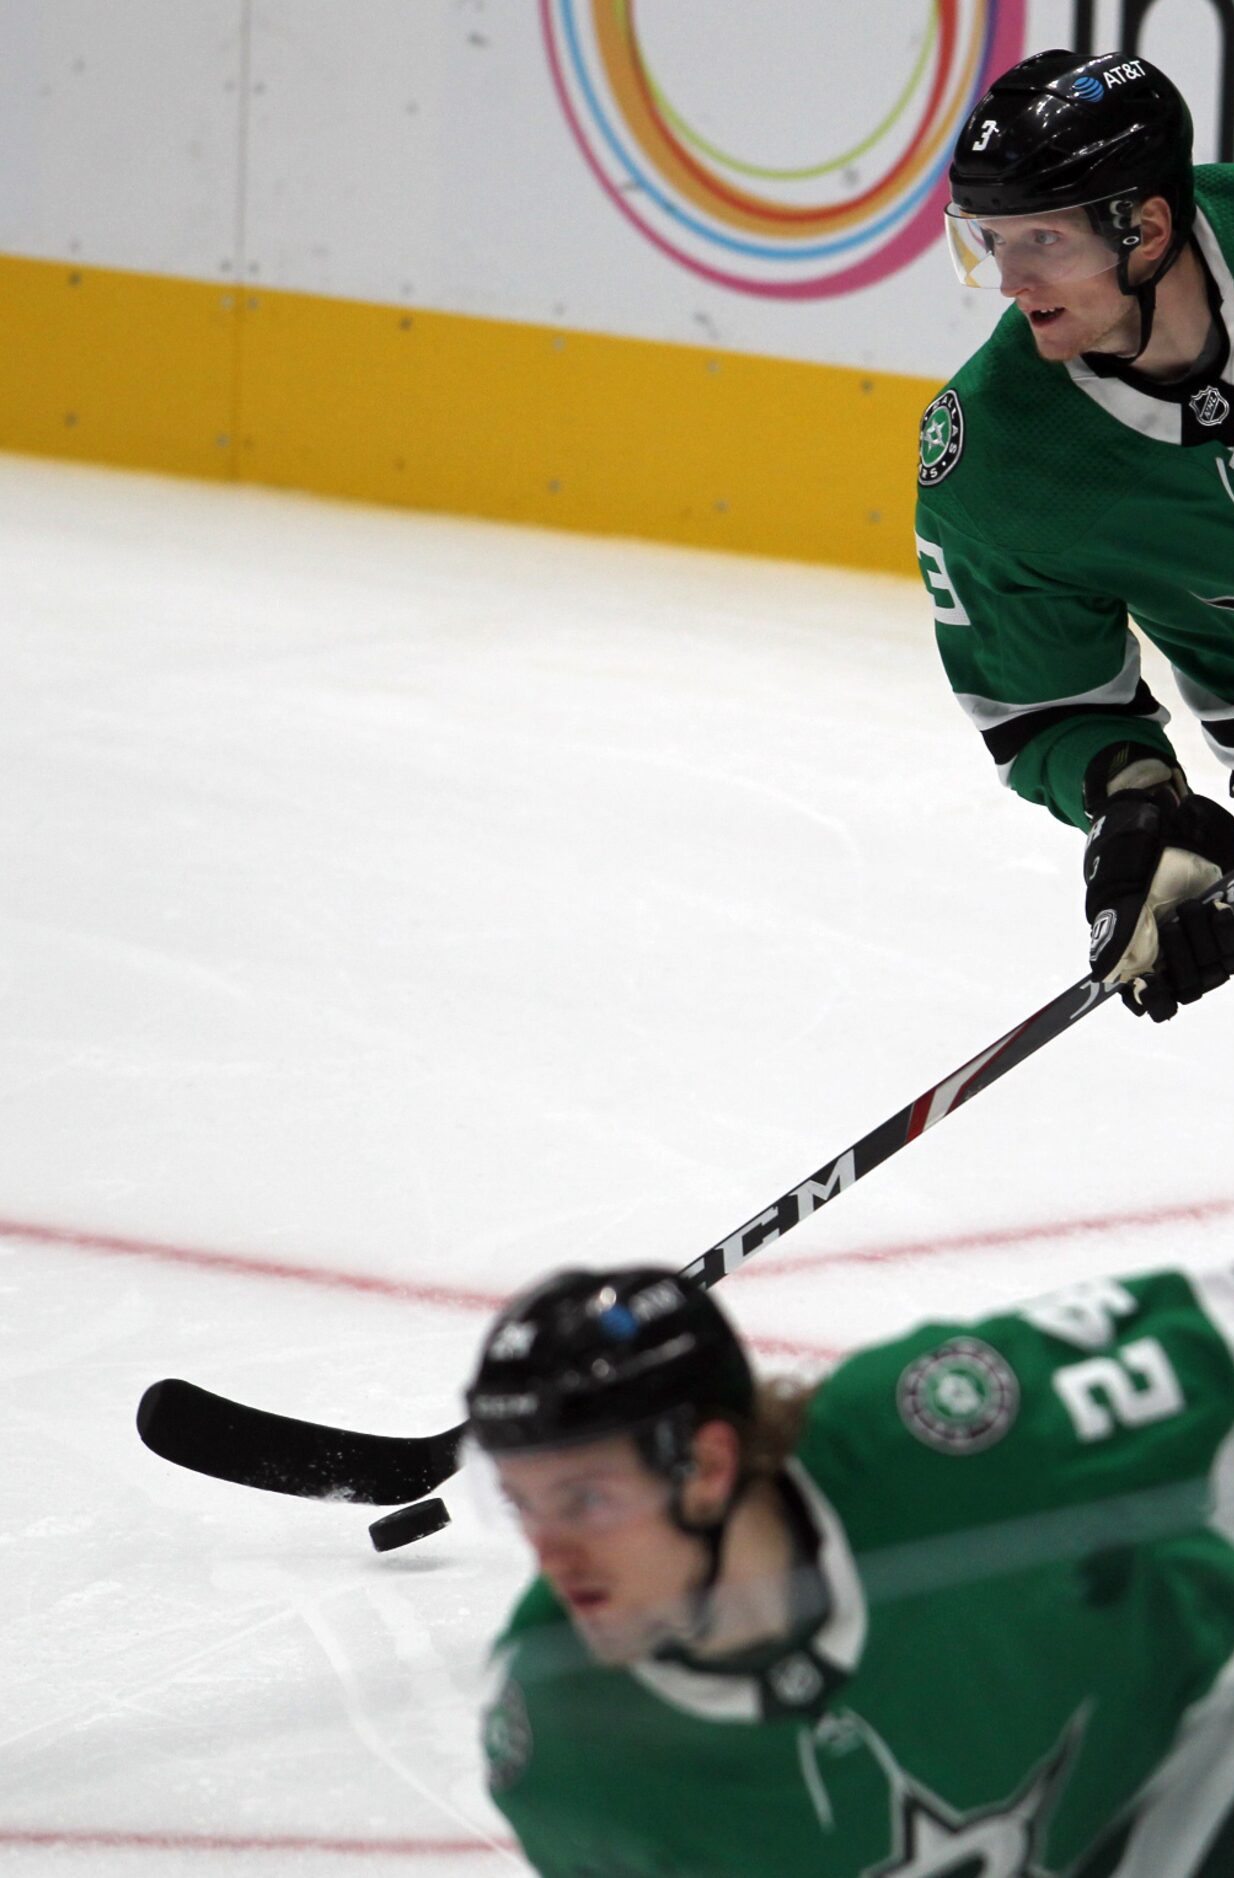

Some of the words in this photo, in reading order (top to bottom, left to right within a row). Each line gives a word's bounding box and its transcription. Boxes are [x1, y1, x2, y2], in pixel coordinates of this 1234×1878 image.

[1103, 60, 1147, 89] AT&T
[972, 119, 1000, 151] 3
[915, 530, 972, 626] 3
